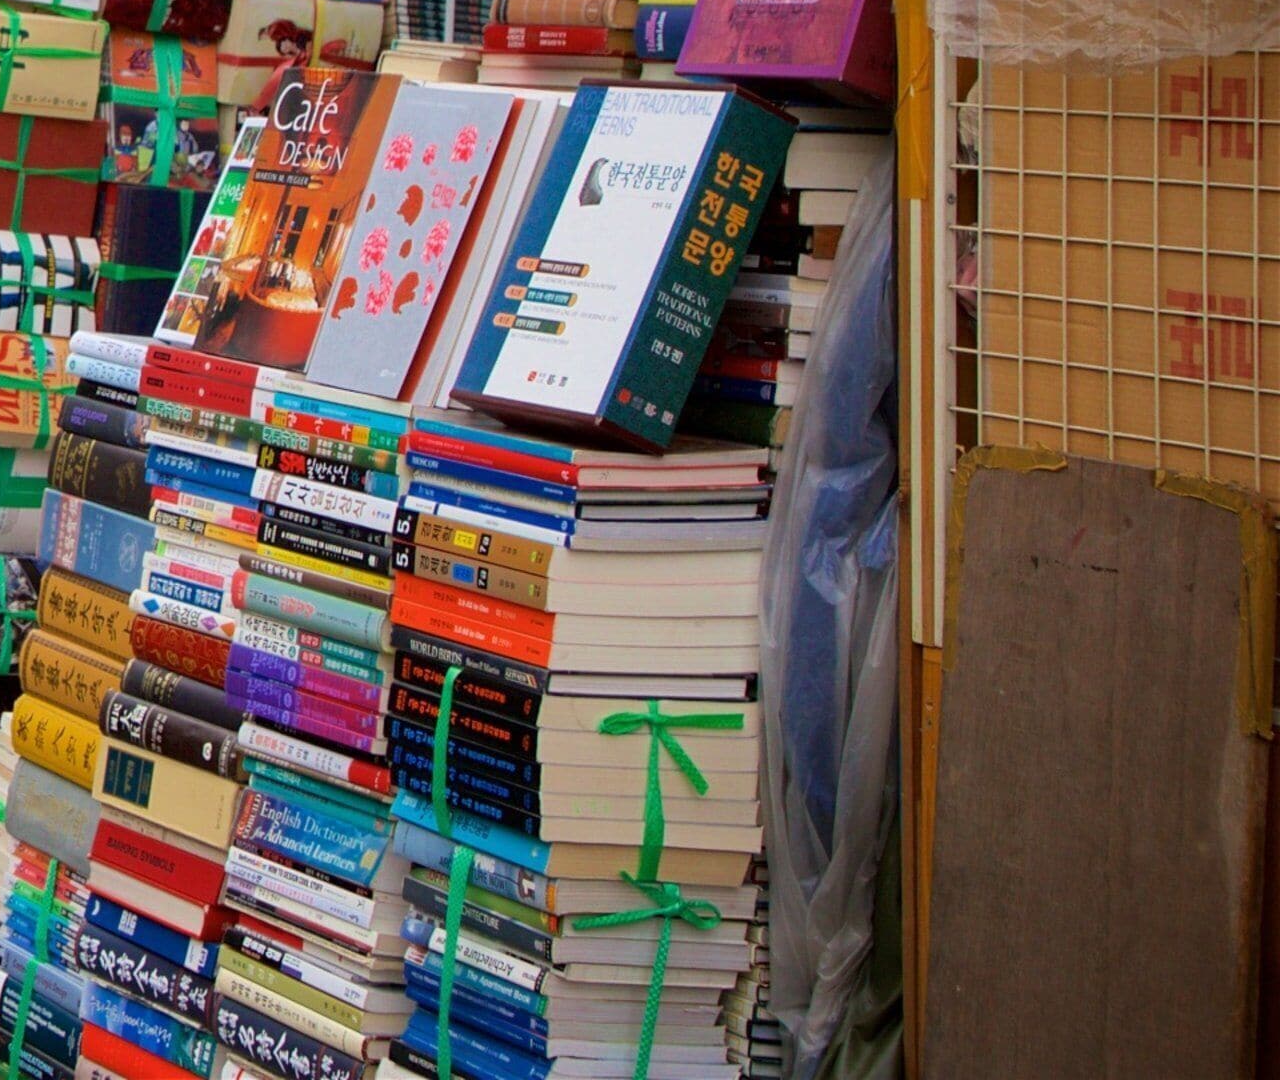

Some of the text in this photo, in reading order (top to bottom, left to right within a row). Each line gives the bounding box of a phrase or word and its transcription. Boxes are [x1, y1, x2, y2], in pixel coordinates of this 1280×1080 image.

[274, 78, 339, 135] Café
[633, 93, 713, 117] TRADITIONAL
[279, 140, 349, 171] DESIGN
[607, 161, 687, 193] 한국전통문양
[714, 151, 765, 202] 한국
[698, 188, 751, 240] 전통
[683, 228, 735, 276] 문양
[656, 291, 712, 328] TRADITIONAL
[672, 282, 711, 308] KOREAN
[656, 308, 702, 338] PATTERNS
[410, 639, 463, 665] WORLD BIRDS
[260, 800, 367, 851] English Dictionary
[108, 838, 176, 873] BANKING SYMBOLS
[251, 826, 356, 873] for Advanced Learners
[481, 975, 513, 998] Apartment
[513, 988, 531, 1004] Book
